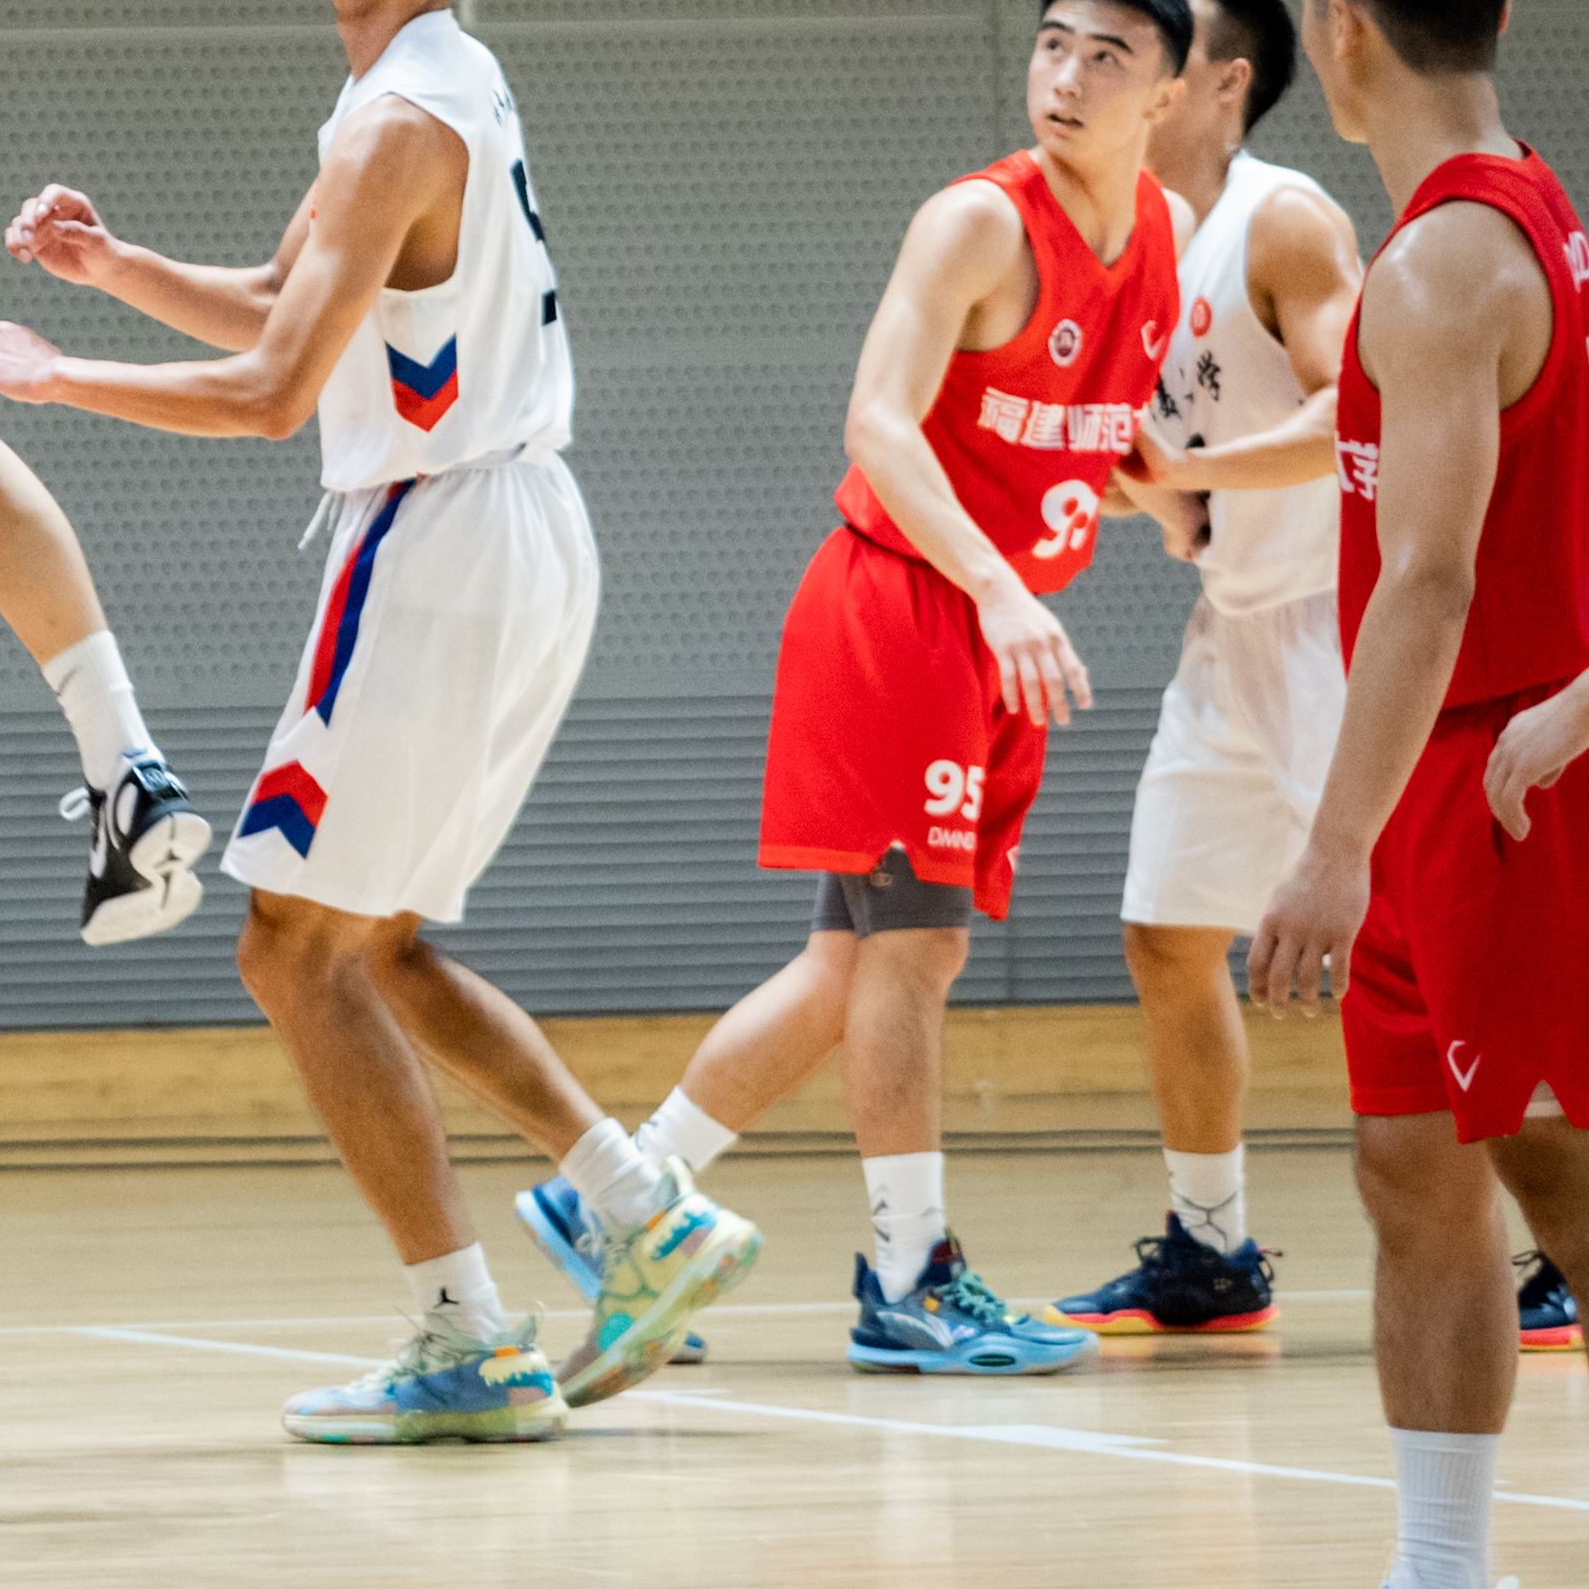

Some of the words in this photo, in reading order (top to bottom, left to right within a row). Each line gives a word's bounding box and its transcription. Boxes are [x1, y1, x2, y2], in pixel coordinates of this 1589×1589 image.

[977, 387, 1149, 454] 福建师范
[924, 759, 985, 821] 95
